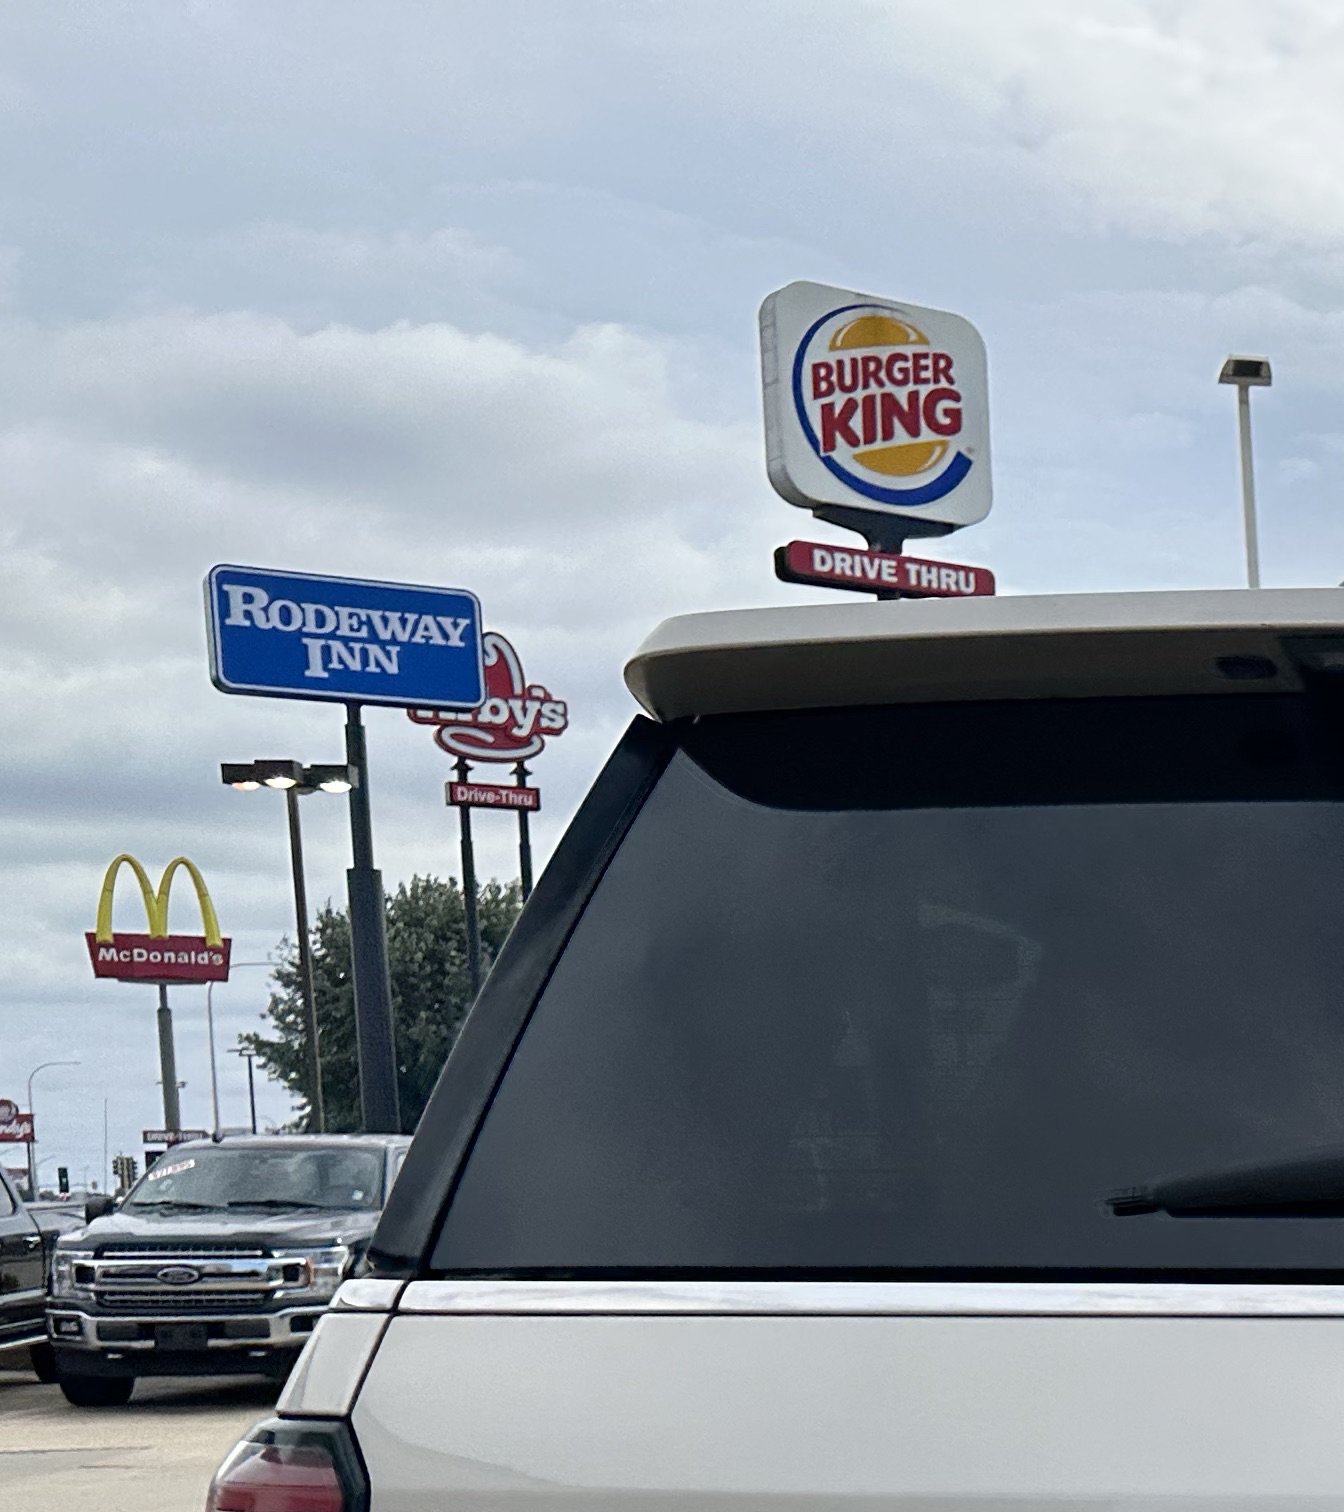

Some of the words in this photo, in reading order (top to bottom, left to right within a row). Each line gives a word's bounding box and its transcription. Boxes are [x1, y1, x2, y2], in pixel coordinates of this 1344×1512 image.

[811, 352, 956, 400] BURGER
[820, 387, 962, 453] KING
[813, 549, 898, 582] DRIVE
[905, 563, 975, 594] THRU
[222, 584, 470, 648] RODEWAY
[301, 637, 400, 678] INN
[416, 686, 567, 737] by's
[457, 786, 533, 806] Drive-Thru
[98, 947, 224, 965] McDonald's
